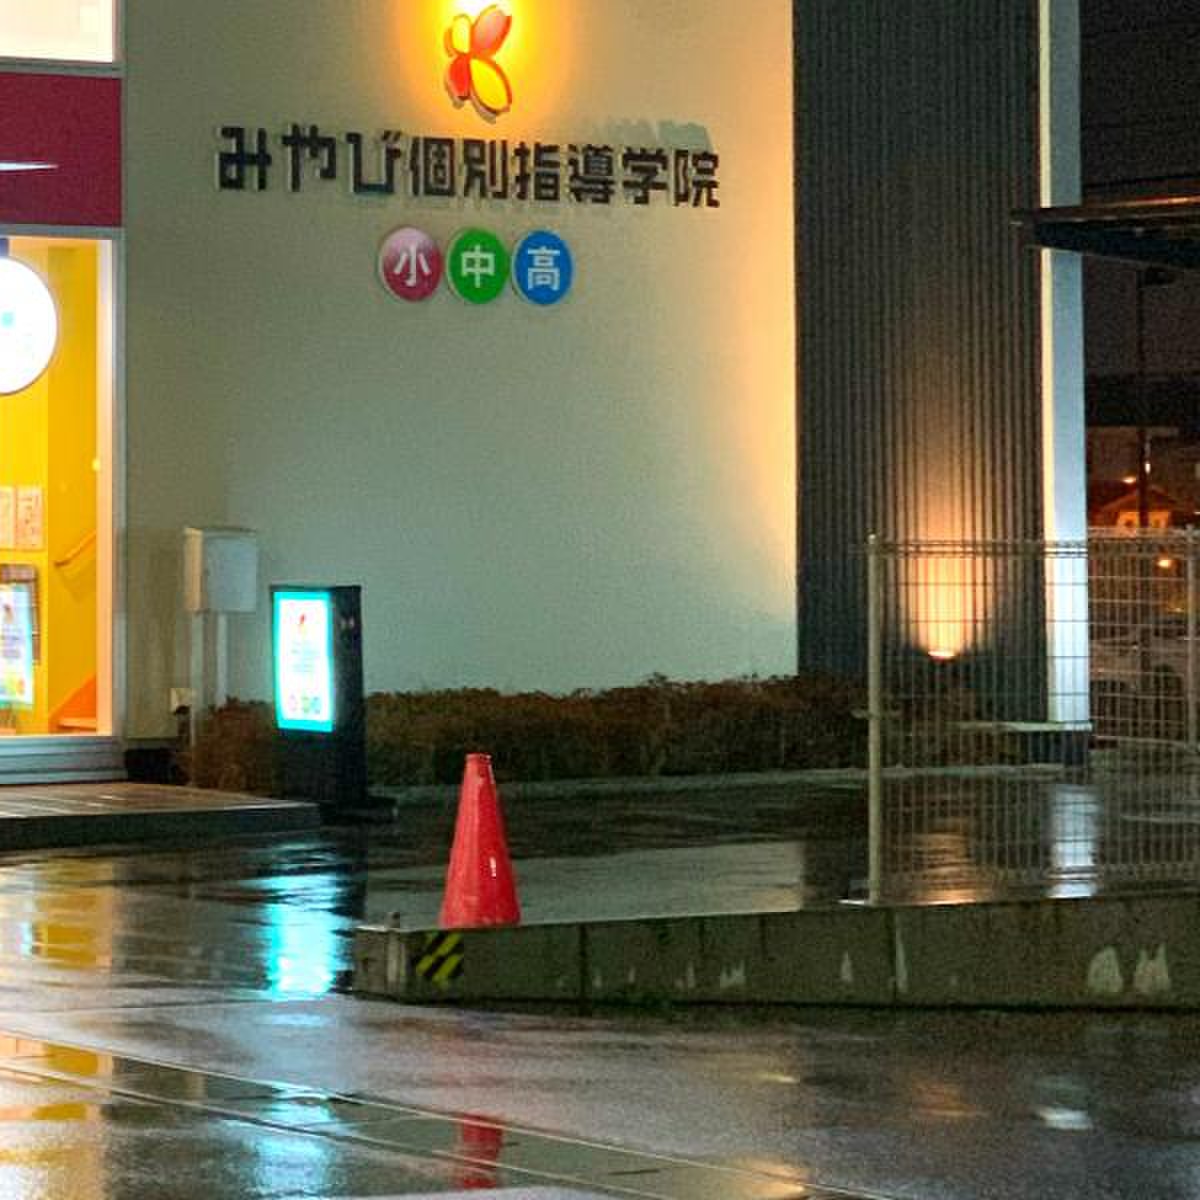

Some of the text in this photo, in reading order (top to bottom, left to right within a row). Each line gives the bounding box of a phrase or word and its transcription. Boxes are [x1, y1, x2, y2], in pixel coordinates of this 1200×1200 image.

[217, 122, 721, 209] みやび個別指導学院
[393, 243, 562, 292] 小 中 高
